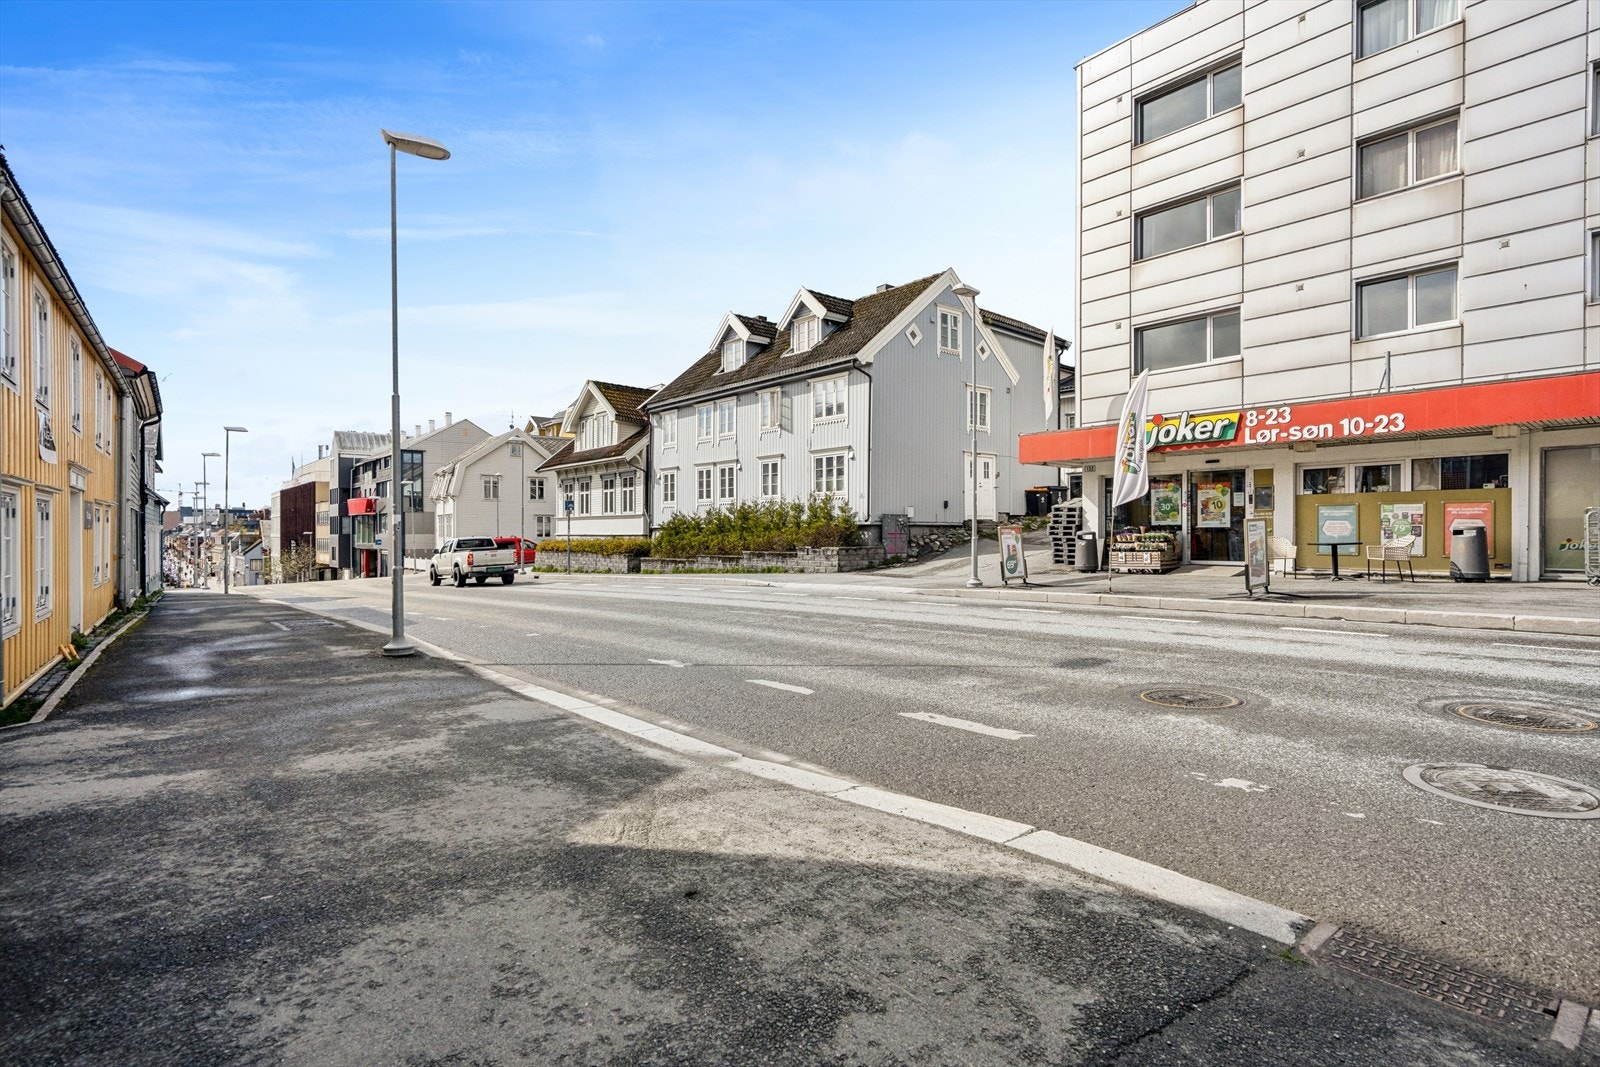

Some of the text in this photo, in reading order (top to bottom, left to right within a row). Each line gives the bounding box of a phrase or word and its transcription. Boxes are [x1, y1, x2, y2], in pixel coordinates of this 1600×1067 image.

[1244, 413, 1406, 444] Lør-søn 10-23
[1245, 407, 1292, 427] 8-23
[1146, 411, 1232, 449] joker
[1211, 500, 1223, 510] 10
